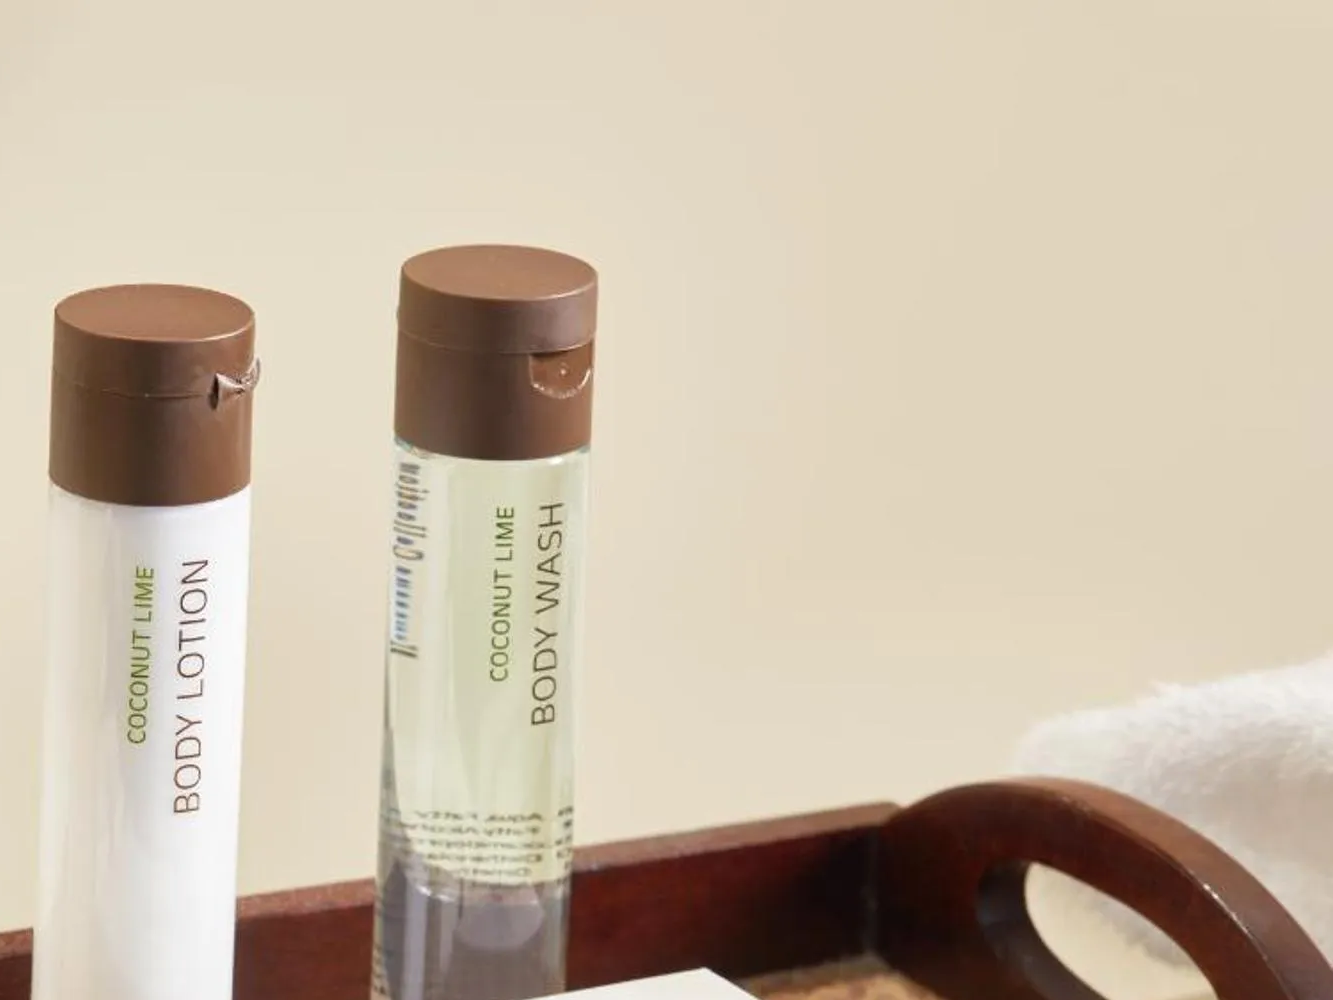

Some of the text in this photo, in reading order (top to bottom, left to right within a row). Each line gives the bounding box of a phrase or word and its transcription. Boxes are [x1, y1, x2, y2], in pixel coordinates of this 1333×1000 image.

[126, 566, 155, 745] COCONUT LIME
[172, 558, 209, 815] BODY LOTION
[489, 507, 515, 682] COCONUT LIME
[530, 502, 564, 726] BODY WASH
